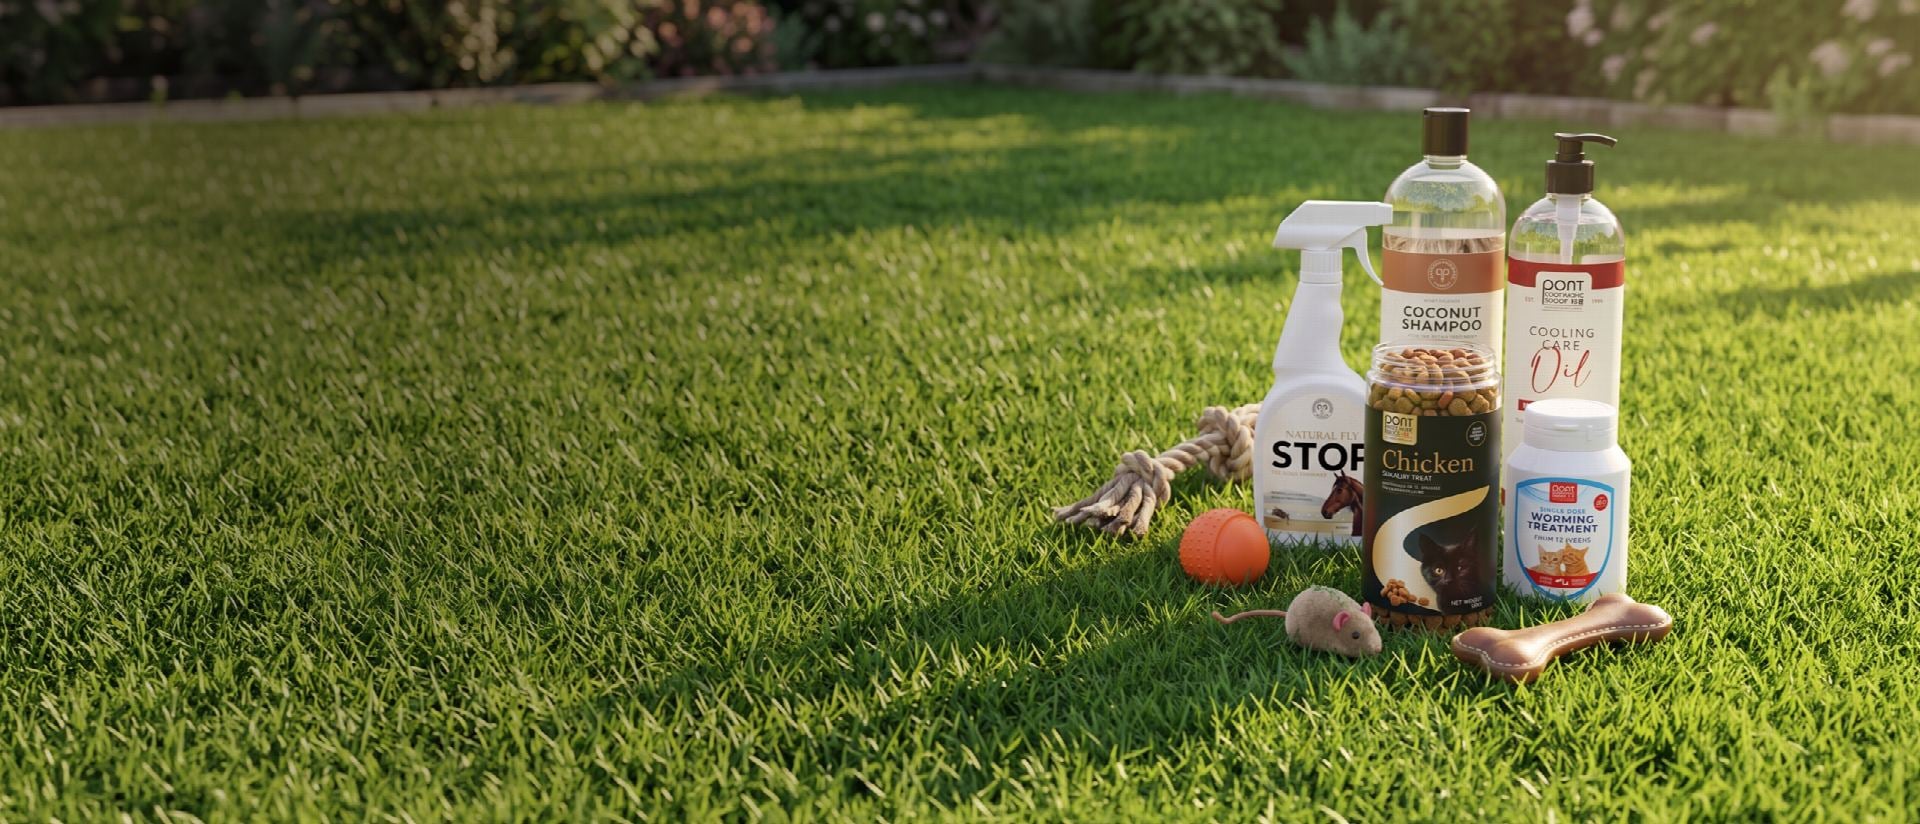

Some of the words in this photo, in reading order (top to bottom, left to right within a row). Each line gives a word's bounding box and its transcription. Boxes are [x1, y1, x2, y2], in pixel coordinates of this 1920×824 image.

[1403, 306, 1482, 318] COCONUT
[1402, 319, 1482, 332] SHAMPOO
[1529, 326, 1595, 338] COOLING
[1542, 340, 1580, 350] CARE
[1531, 346, 1591, 394] Oil
[1285, 430, 1338, 440] NATURAL
[1341, 432, 1360, 440] FLY
[1382, 449, 1474, 474] Chicken
[1540, 506, 1564, 514] SINGLE
[1531, 512, 1594, 524] WORMING
[1528, 521, 1598, 533] TREATMENT
